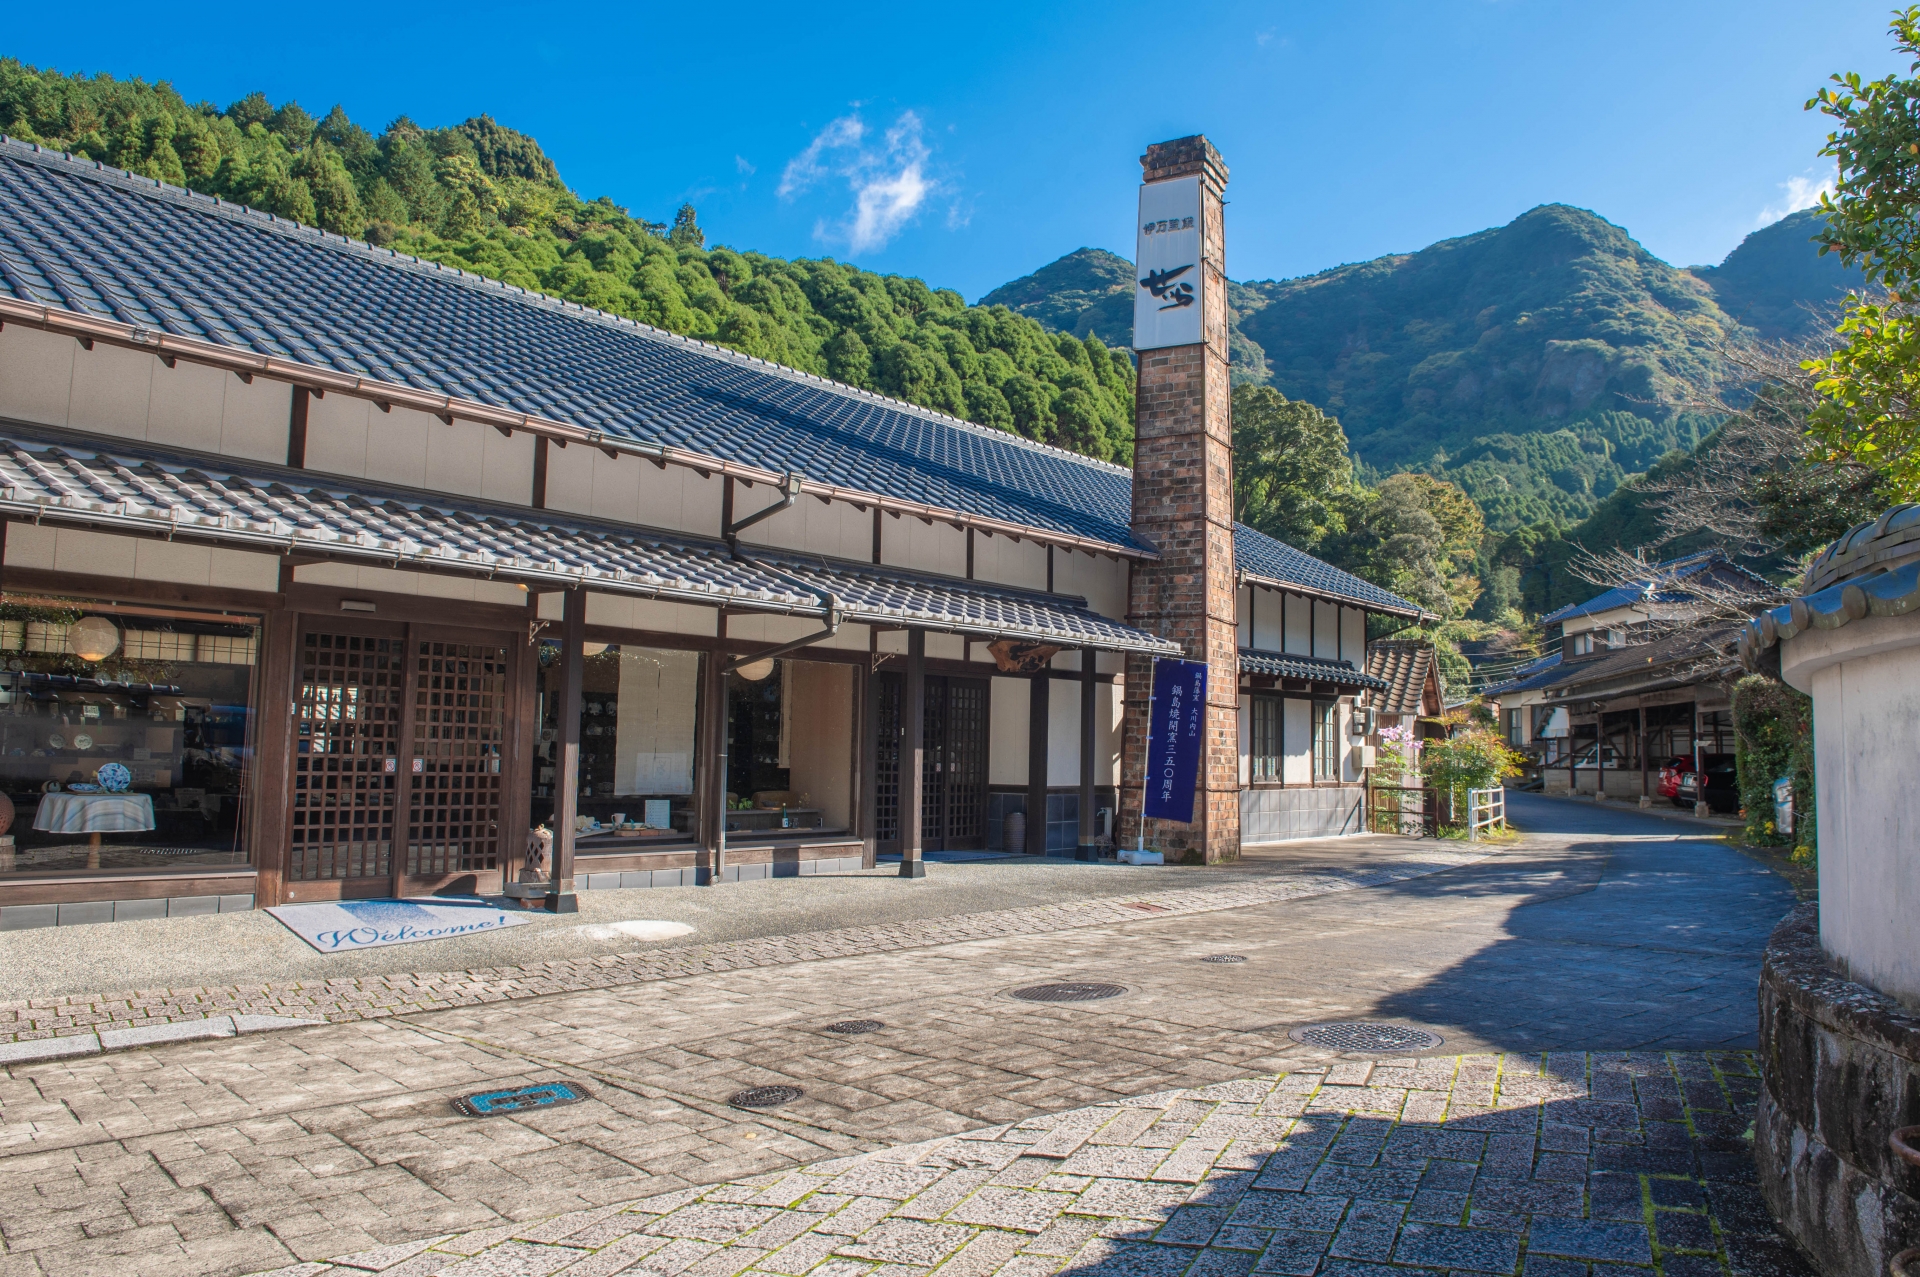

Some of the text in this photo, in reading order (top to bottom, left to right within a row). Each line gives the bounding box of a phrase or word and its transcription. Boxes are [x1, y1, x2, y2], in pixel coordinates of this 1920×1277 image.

[1143, 217, 1194, 236] 伊万里焼
[1188, 707, 1199, 737] 大川内山
[317, 915, 506, 948] Welcome!
